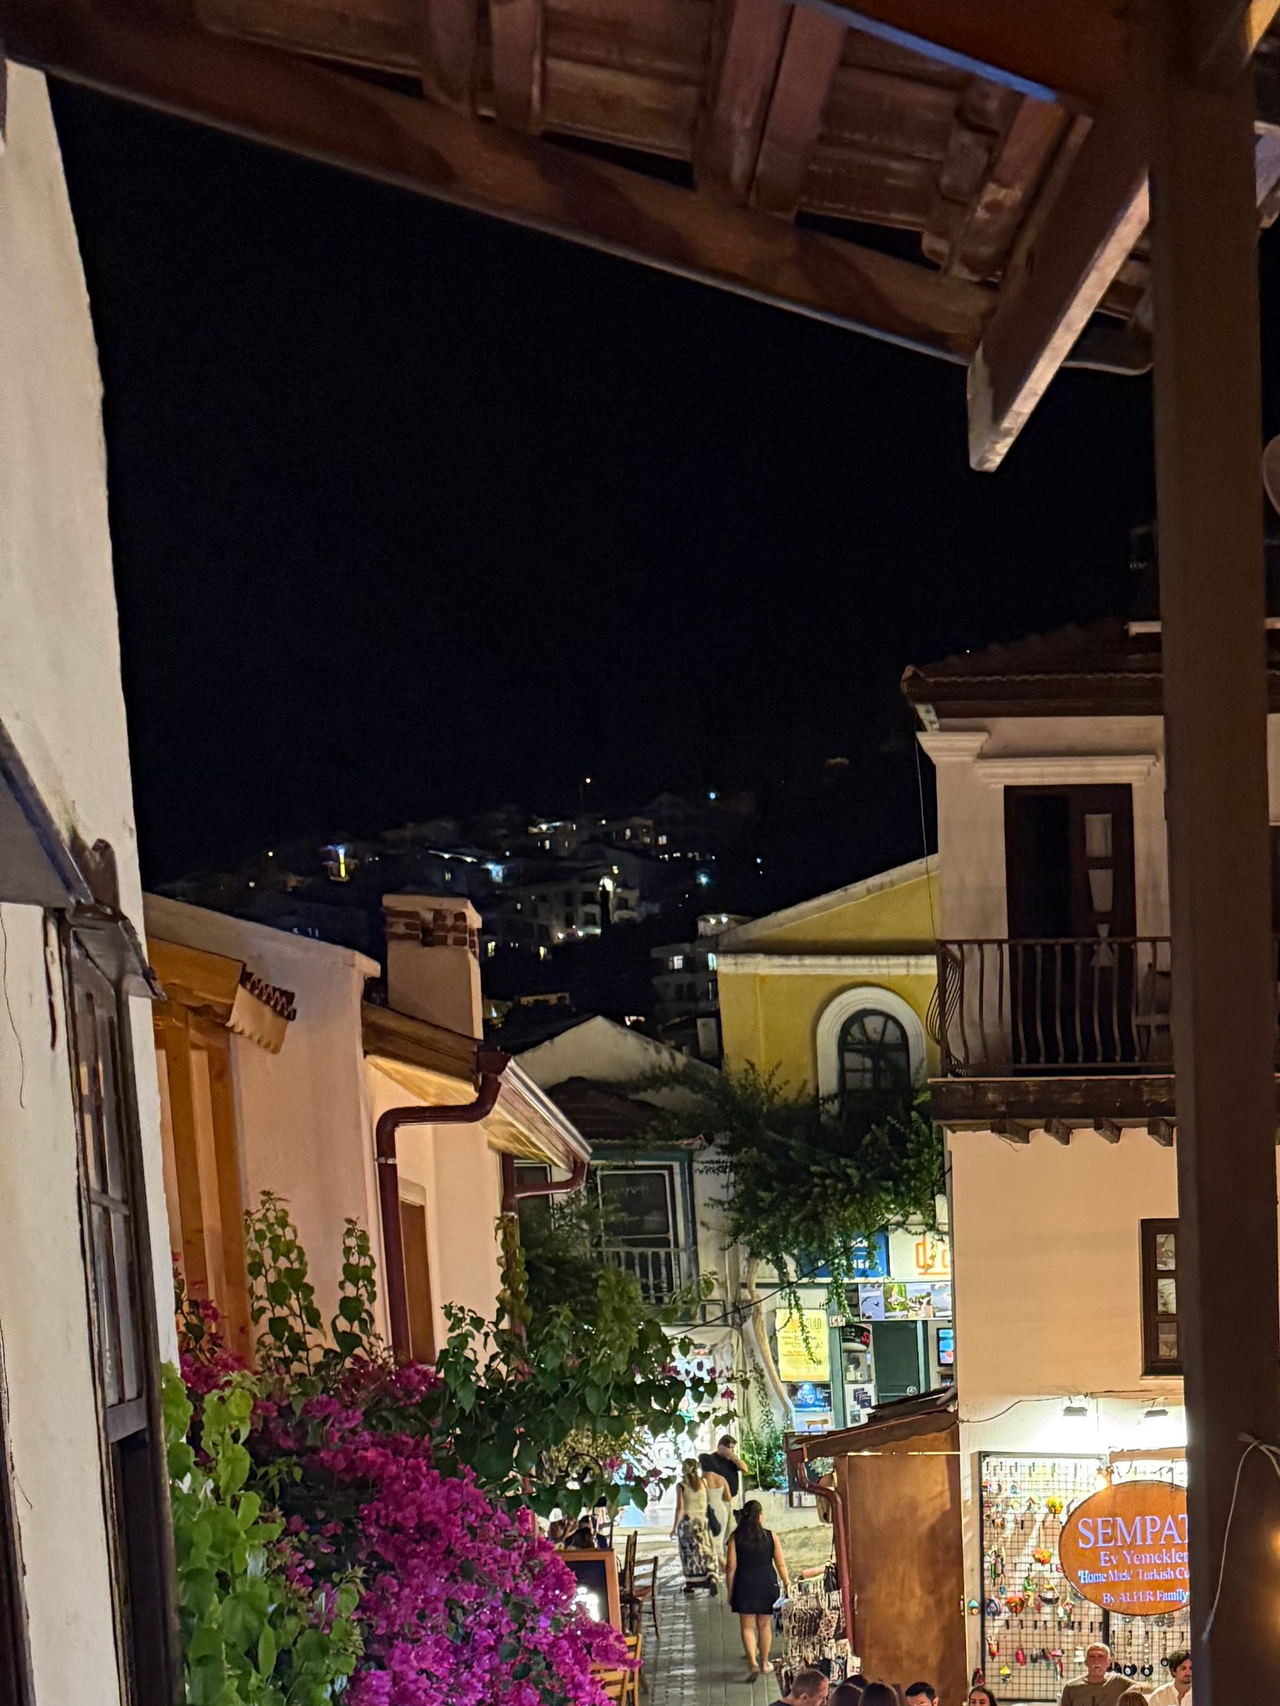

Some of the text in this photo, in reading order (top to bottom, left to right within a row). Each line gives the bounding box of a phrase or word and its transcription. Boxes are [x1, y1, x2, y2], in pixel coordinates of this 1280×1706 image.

[1099, 1551, 1119, 1567] Ev
[1136, 1567, 1174, 1581] Turkish
[1156, 1588, 1188, 1605] Family
